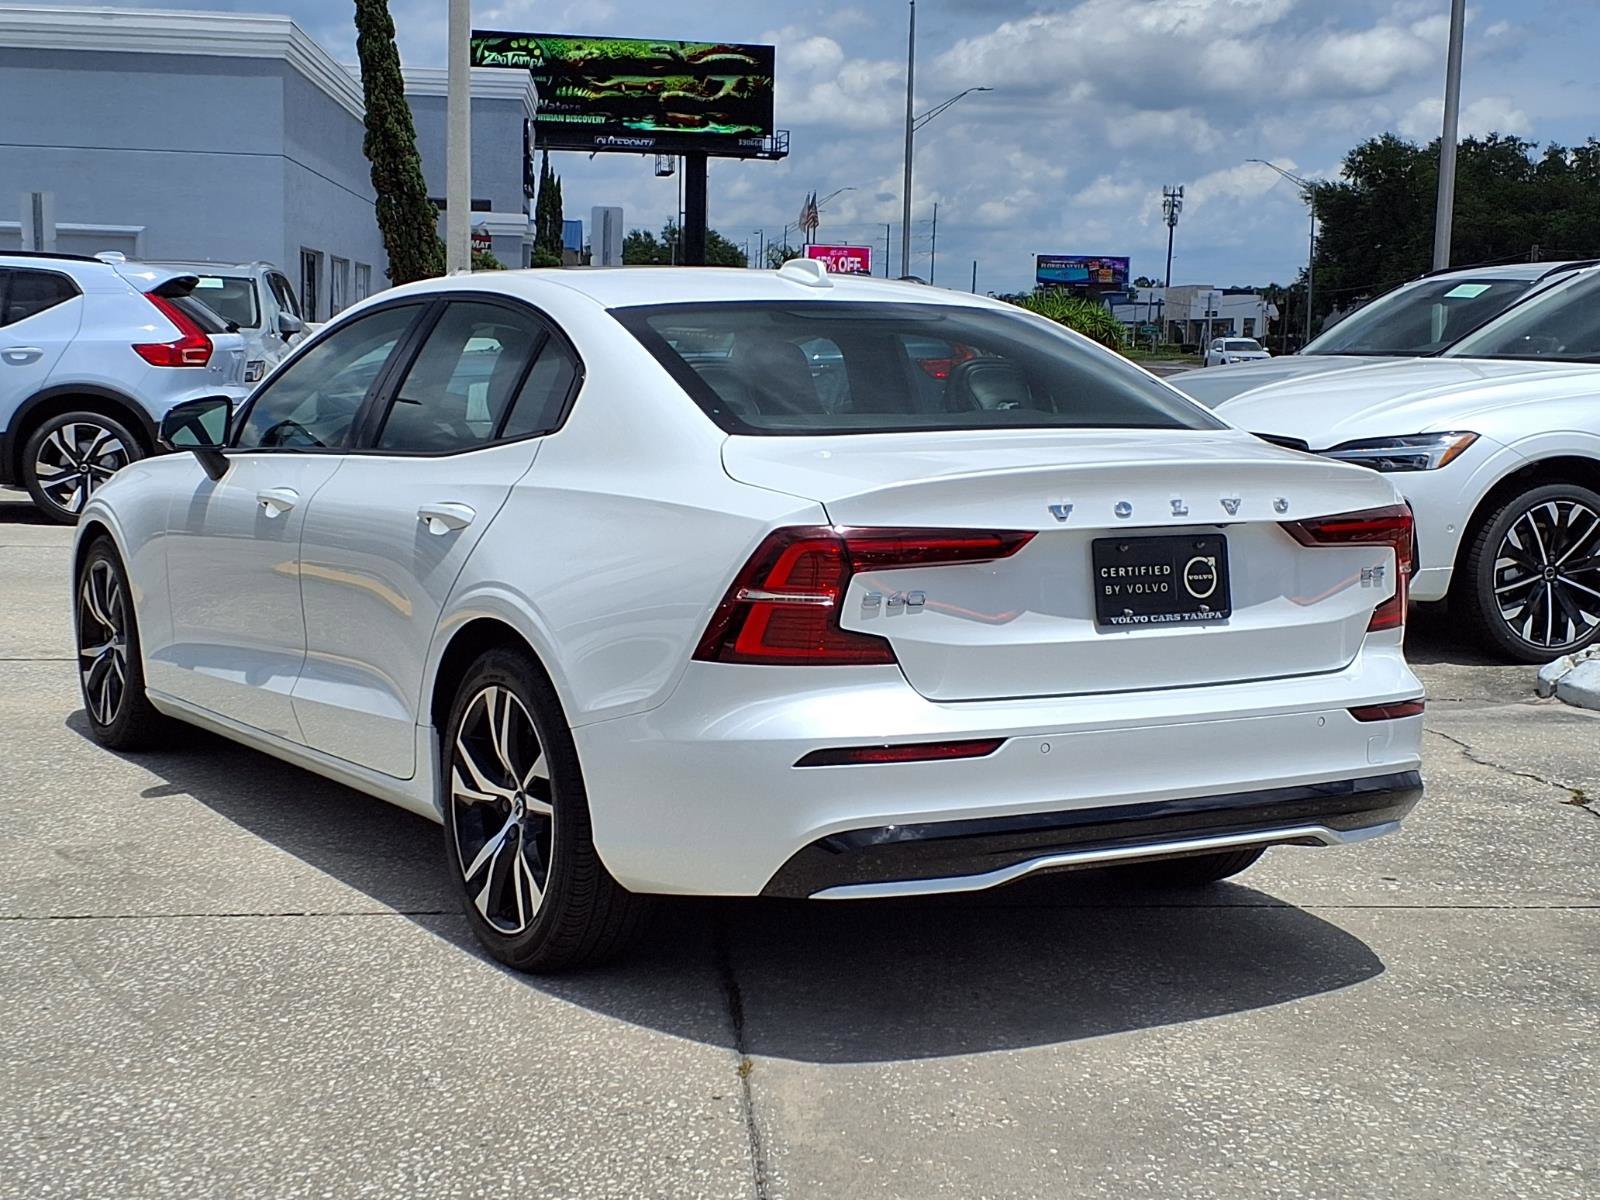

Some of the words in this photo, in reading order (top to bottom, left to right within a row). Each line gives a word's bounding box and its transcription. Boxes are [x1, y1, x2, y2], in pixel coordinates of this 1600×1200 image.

[565, 114, 606, 124] DISCOVERY
[838, 257, 862, 272] OFF
[1048, 497, 1289, 522] VOLVO
[1101, 566, 1171, 577] CERTIFIED
[1105, 585, 1120, 595] BY
[1127, 583, 1168, 593] VOLVO
[1111, 614, 1148, 624] VOLVO
[1150, 613, 1181, 622] CARS
[1182, 611, 1222, 620] TAMPA
